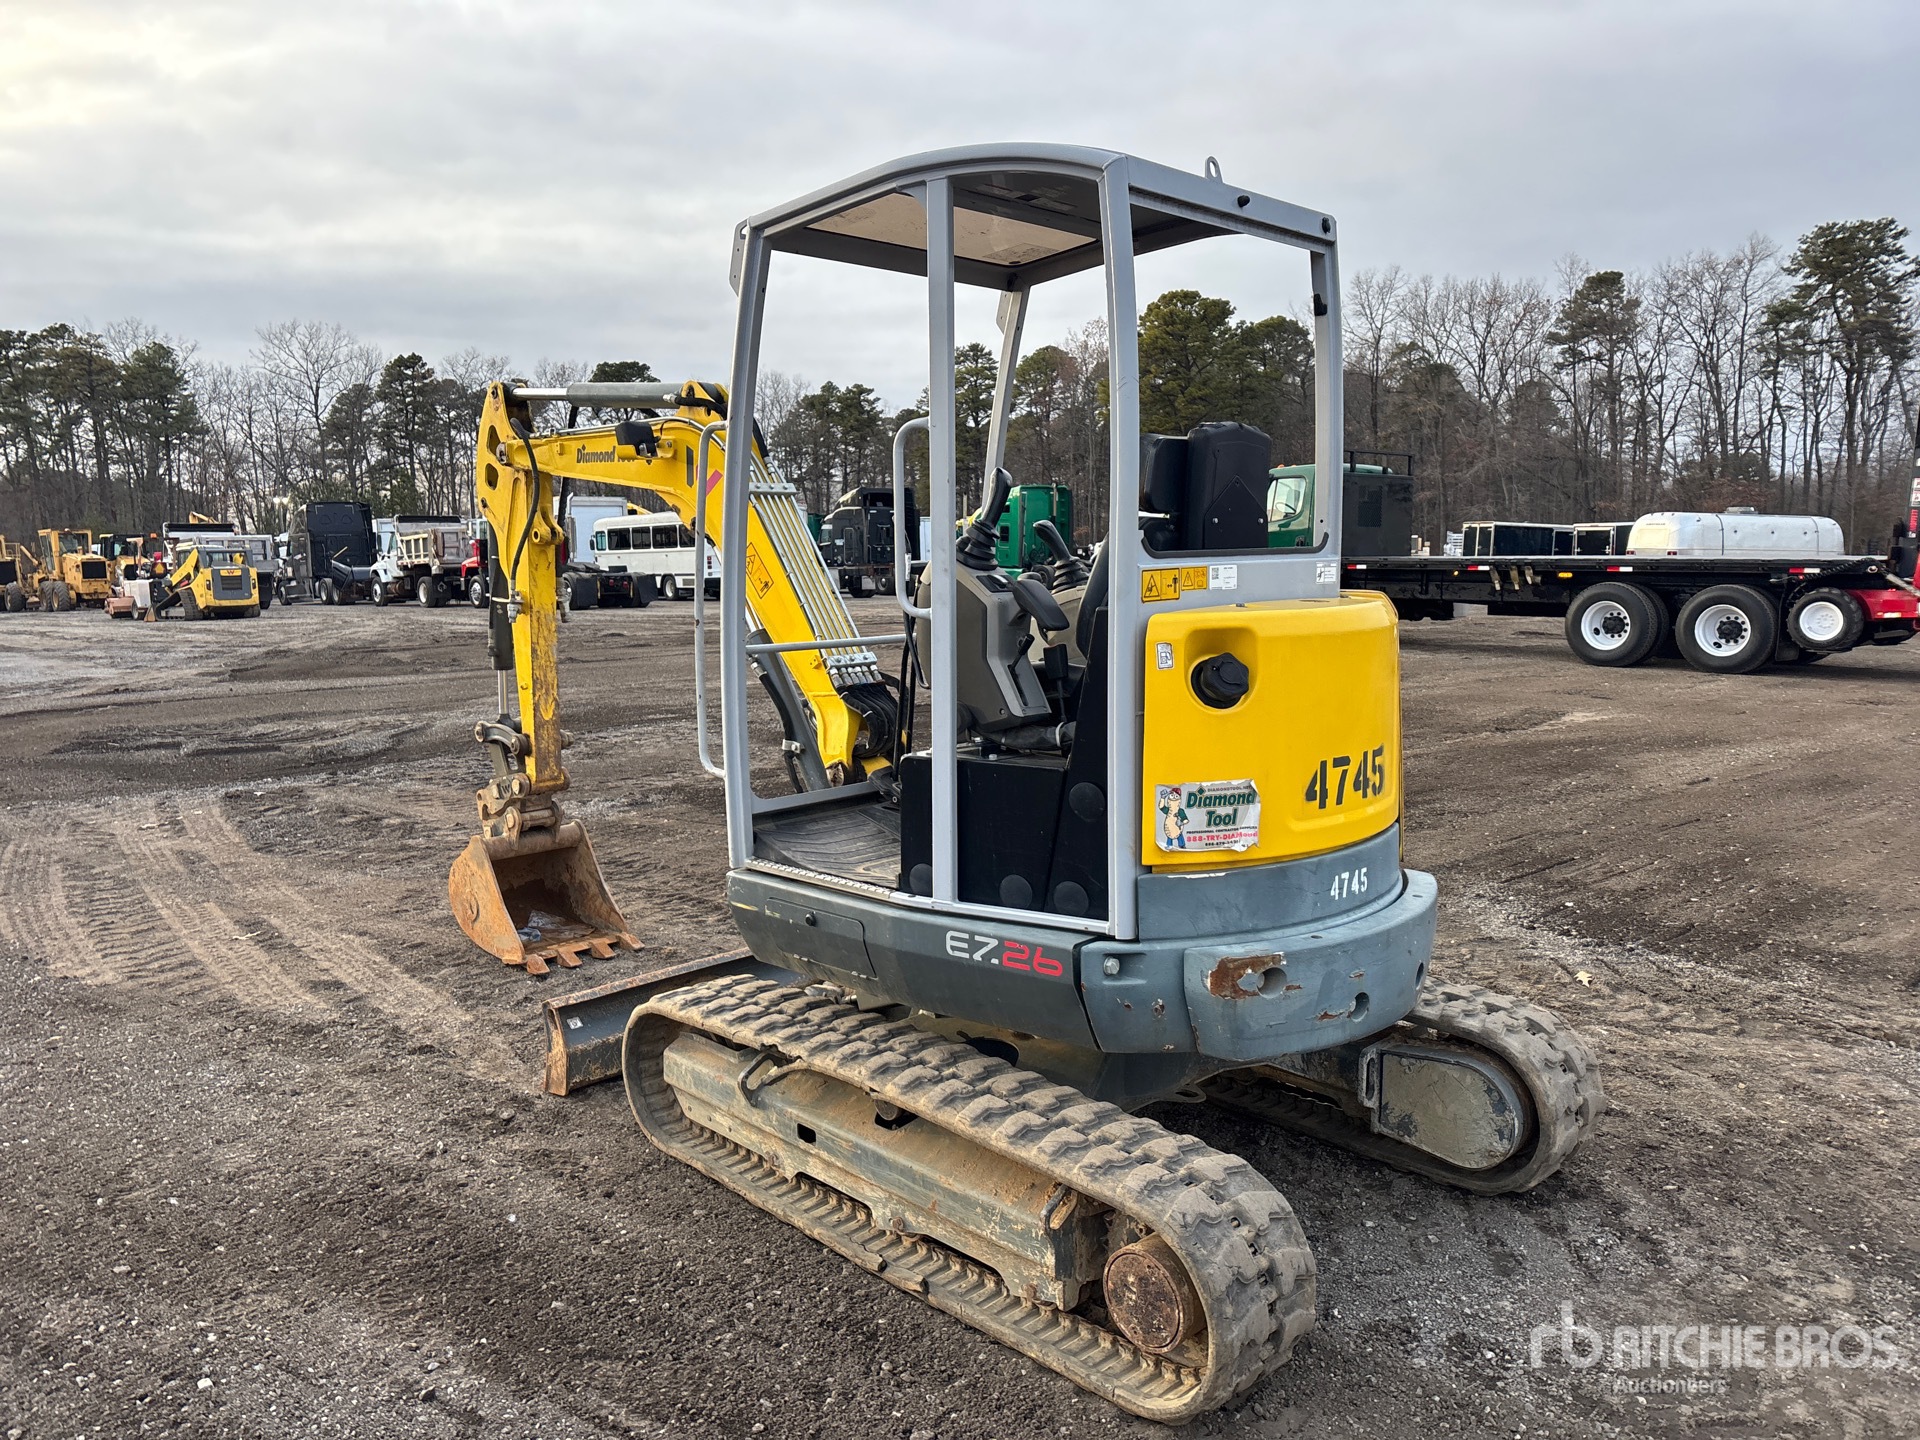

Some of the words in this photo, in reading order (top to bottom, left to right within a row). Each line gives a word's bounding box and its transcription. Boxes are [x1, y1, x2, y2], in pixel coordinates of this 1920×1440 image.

[576, 444, 617, 464] Diamond
[1305, 743, 1384, 810] 4745
[1186, 786, 1256, 808] Diamond
[1206, 808, 1238, 827] Tool
[1330, 867, 1368, 901] 4745
